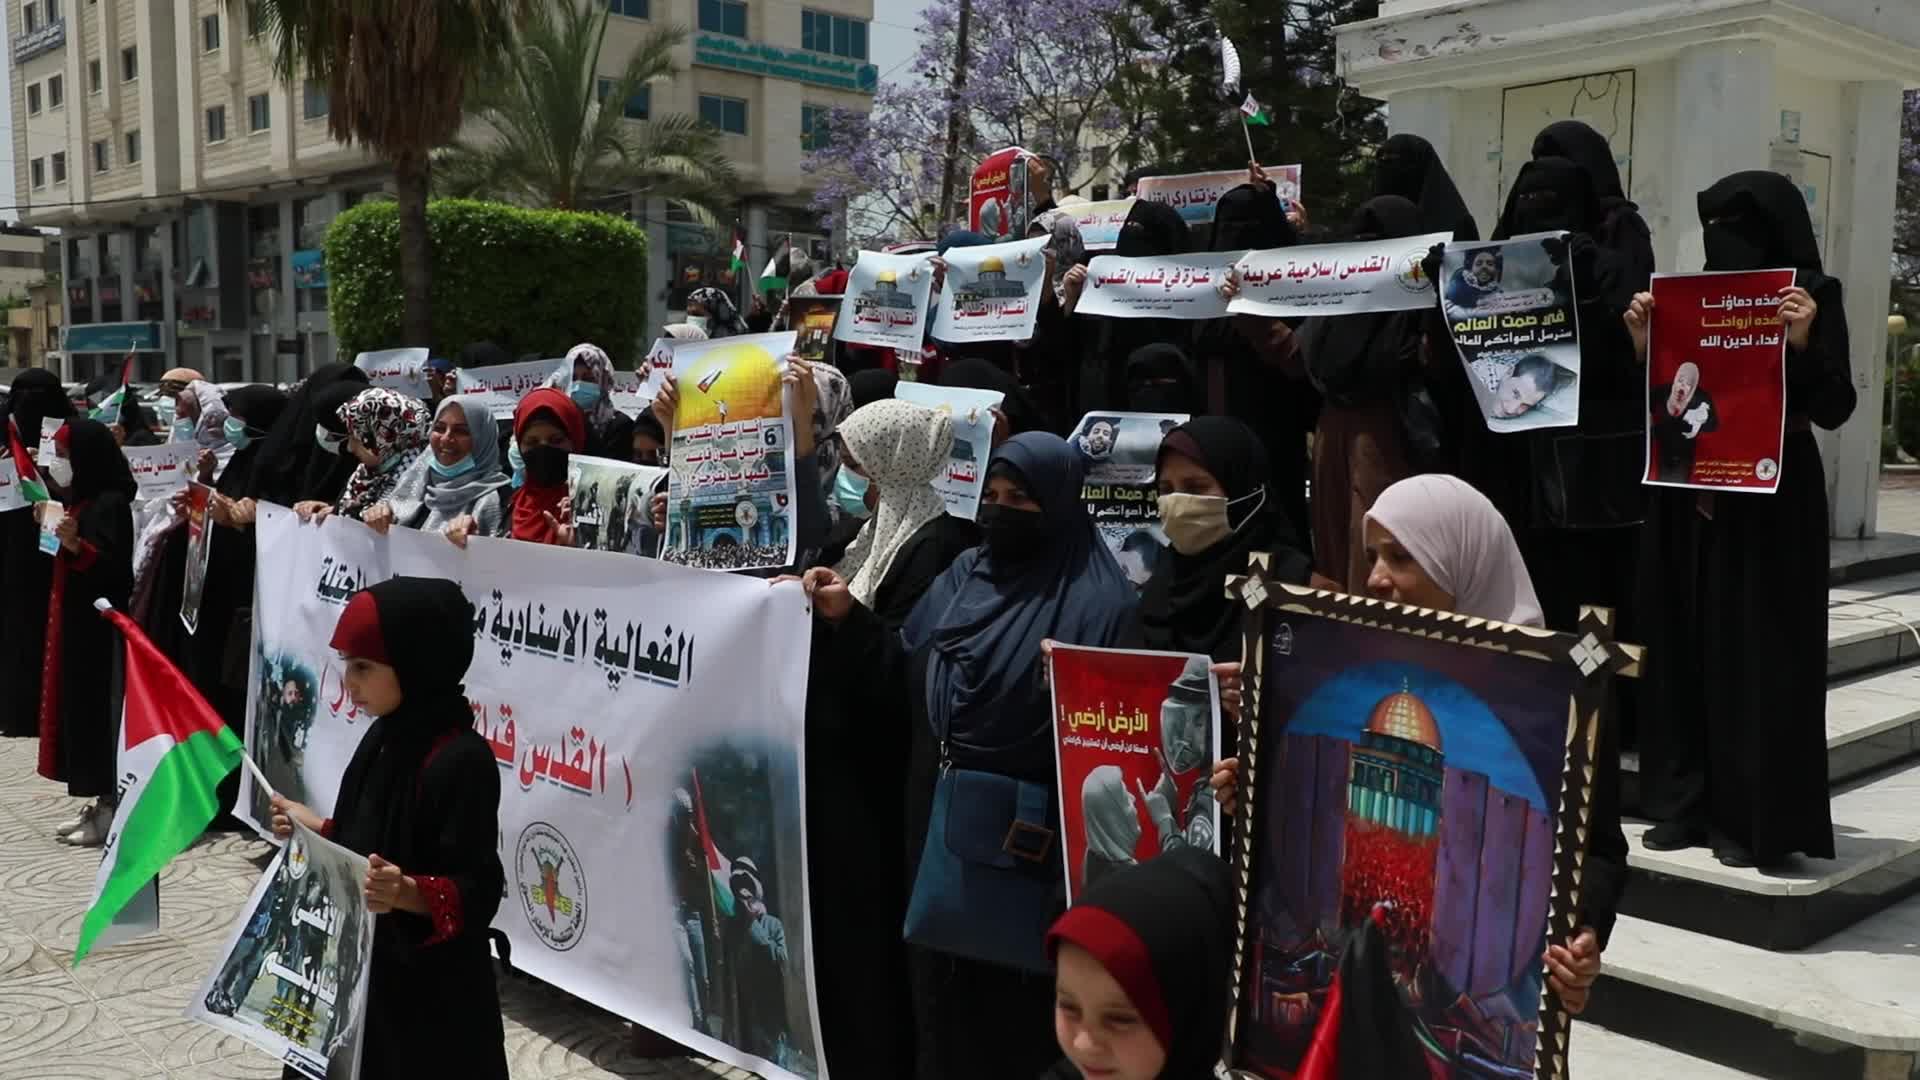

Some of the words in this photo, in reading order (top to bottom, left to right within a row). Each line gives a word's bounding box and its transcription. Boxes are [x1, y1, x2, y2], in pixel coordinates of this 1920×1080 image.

[1135, 267, 1164, 288] قلب
[1182, 267, 1210, 288] غزة
[1242, 264, 1282, 287] عربية
[1287, 258, 1338, 283] إسلامية
[1339, 256, 1391, 280] القدس
[1094, 268, 1135, 289] القدس
[1165, 267, 1181, 292] في
[1702, 294, 1752, 311] دماؤنا
[1755, 293, 1782, 307] هذه
[854, 307, 885, 325] القدس
[953, 300, 992, 321] القدس
[1454, 315, 1497, 332] العالم
[1502, 314, 1538, 329] صمت
[1701, 311, 1752, 330] أرواحنا
[1754, 314, 1781, 327] هذه
[1538, 329, 1573, 344] سنرسل
[1700, 334, 1721, 348] الله
[1723, 334, 1752, 349] لدين
[687, 425, 716, 444] القدس
[764, 427, 777, 446] 6
[740, 446, 764, 461] ومن
[744, 465, 769, 482] فيها
[1080, 485, 1111, 501] العال
[1113, 487, 1143, 501] صمت
[317, 556, 368, 602] الحتلة
[490, 588, 588, 662] الاسنادية
[594, 607, 695, 688] الفعالية
[1068, 701, 1105, 732] أرضي
[519, 726, 607, 796] القدس
